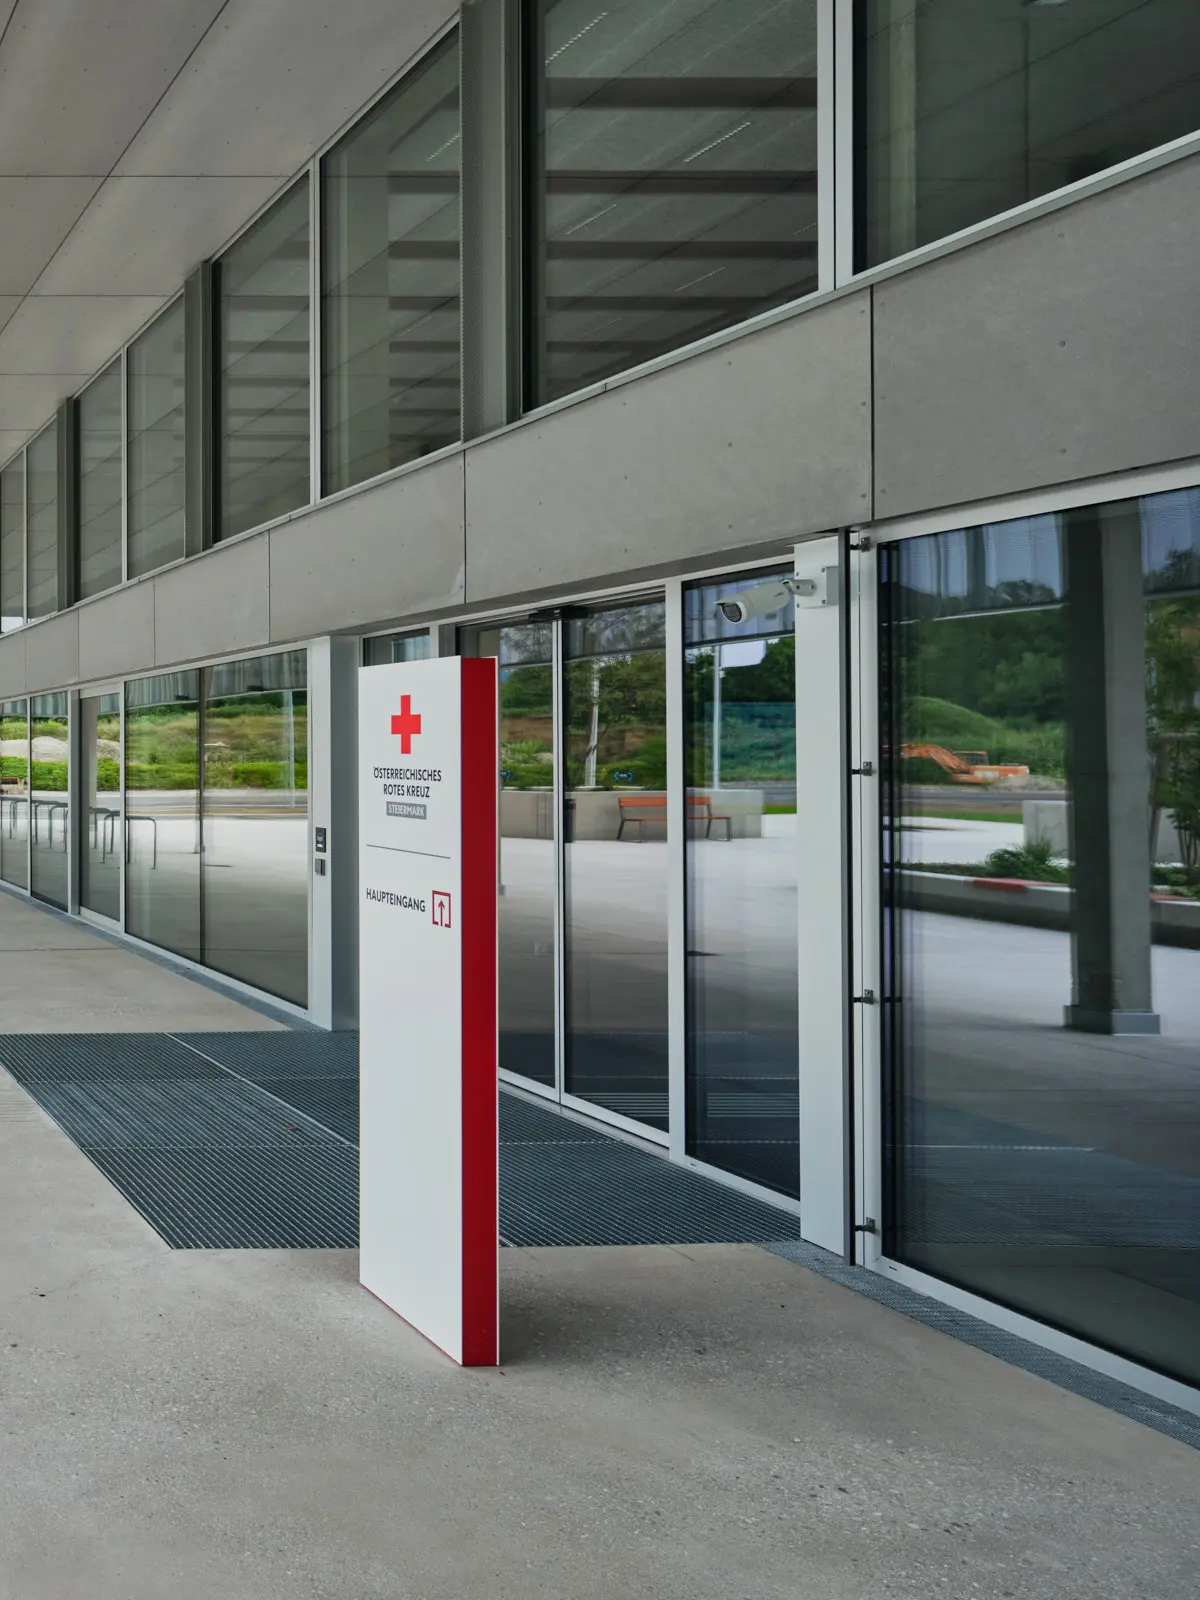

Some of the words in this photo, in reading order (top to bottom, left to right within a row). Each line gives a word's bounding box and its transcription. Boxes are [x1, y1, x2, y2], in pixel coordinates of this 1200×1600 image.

[373, 766, 442, 781] ÖSTERREICHISCHES
[383, 784, 405, 796] ROTES
[406, 785, 431, 798] KREUZ
[388, 804, 425, 817] STEIERMARK
[366, 888, 426, 912] HAUPTEINGANG
